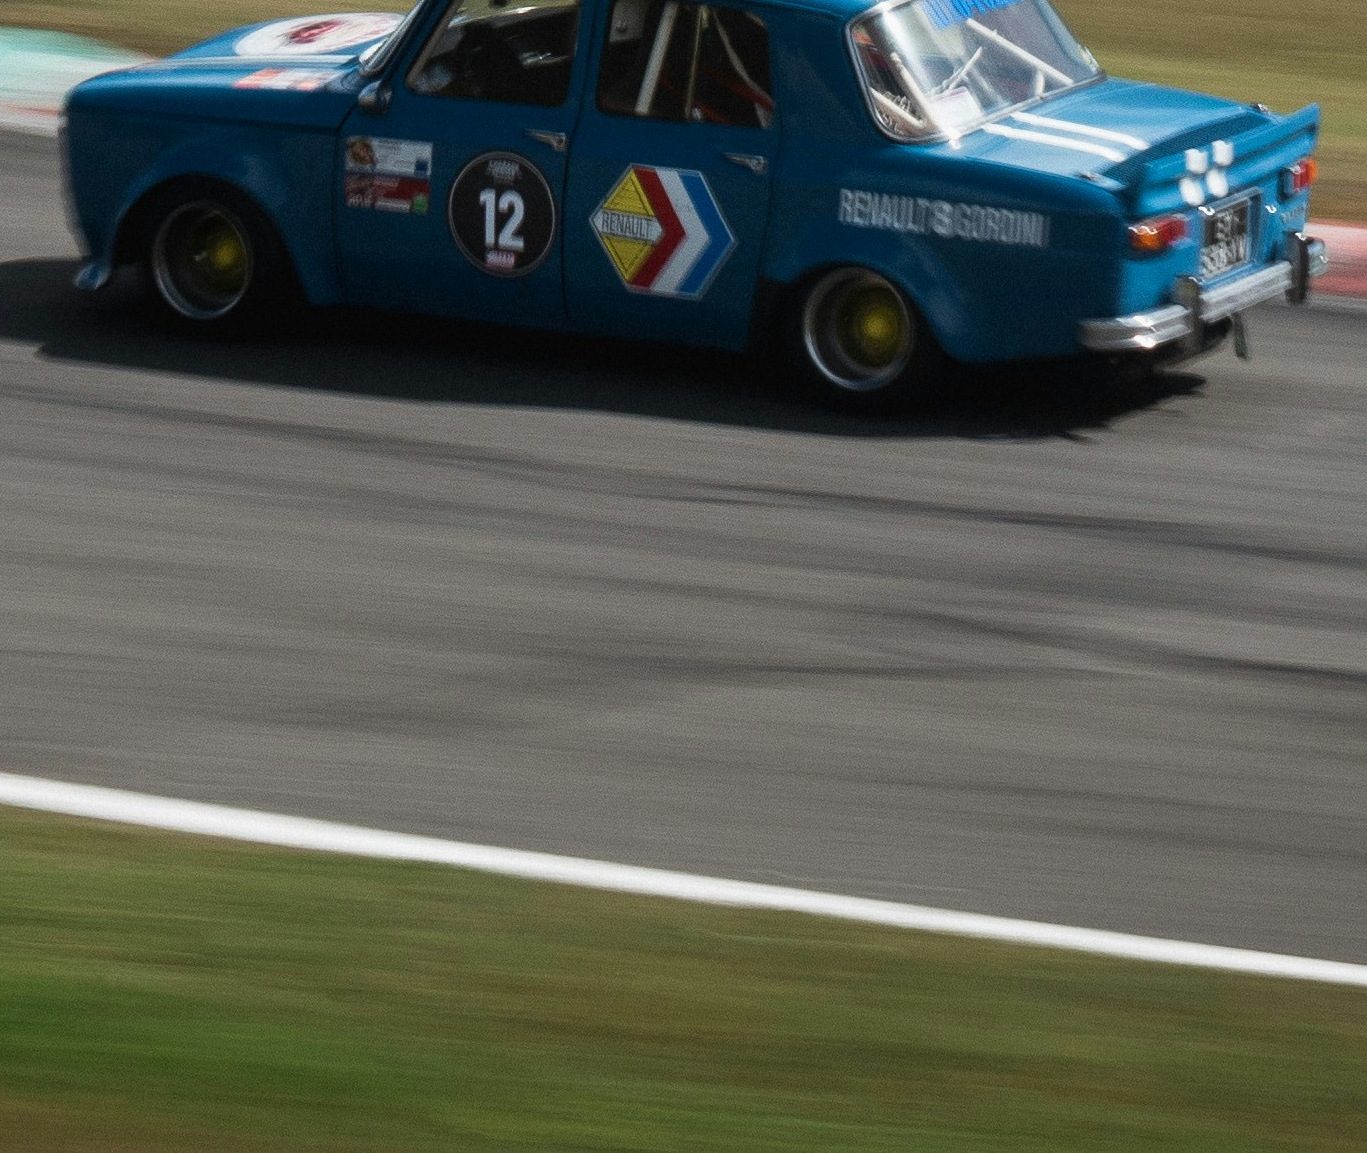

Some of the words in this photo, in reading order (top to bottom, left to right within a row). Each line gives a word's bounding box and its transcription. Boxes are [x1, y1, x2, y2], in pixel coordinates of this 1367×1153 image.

[479, 188, 525, 252] 12
[600, 211, 652, 239] RENAULT
[838, 188, 931, 234] RENAULT
[954, 202, 1051, 248] GORDINI
